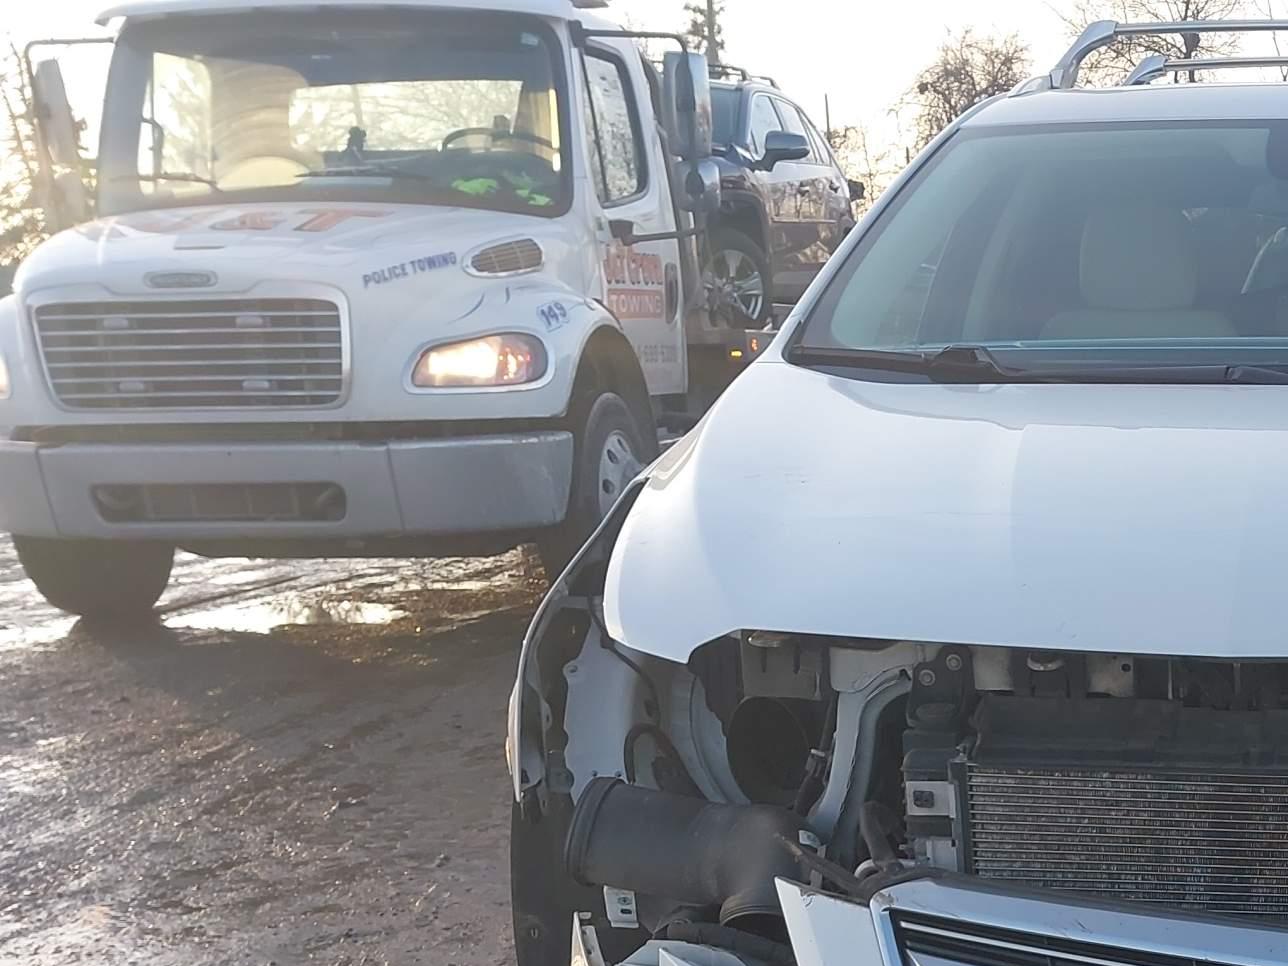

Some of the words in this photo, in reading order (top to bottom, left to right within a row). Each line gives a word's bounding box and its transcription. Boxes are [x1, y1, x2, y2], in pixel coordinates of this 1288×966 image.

[363, 264, 408, 287] POLICE
[410, 251, 457, 273] TOWING
[540, 301, 568, 327] 149
[609, 293, 661, 314] TOWING
